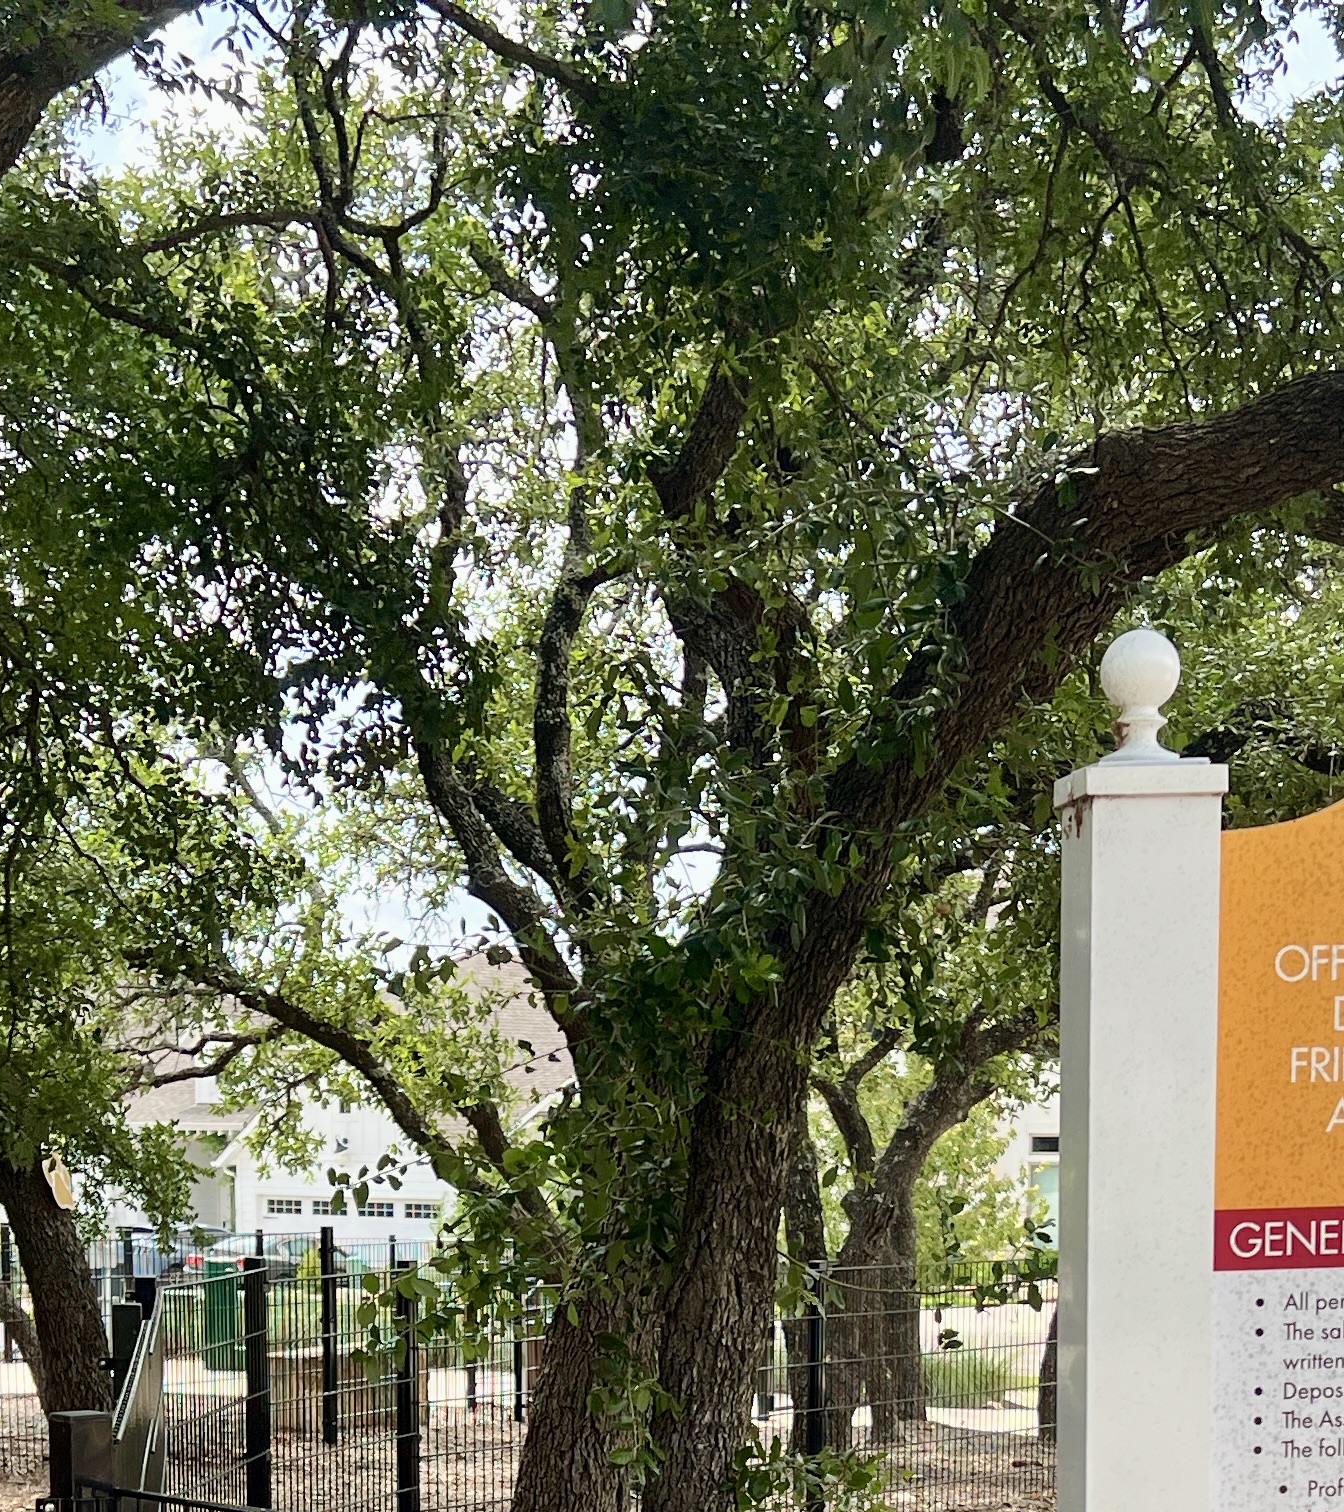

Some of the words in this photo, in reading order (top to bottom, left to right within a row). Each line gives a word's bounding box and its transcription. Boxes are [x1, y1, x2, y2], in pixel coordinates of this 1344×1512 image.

[1282, 1290, 1308, 1311] All
[1280, 1409, 1313, 1429] The
[1280, 1438, 1312, 1458] The
